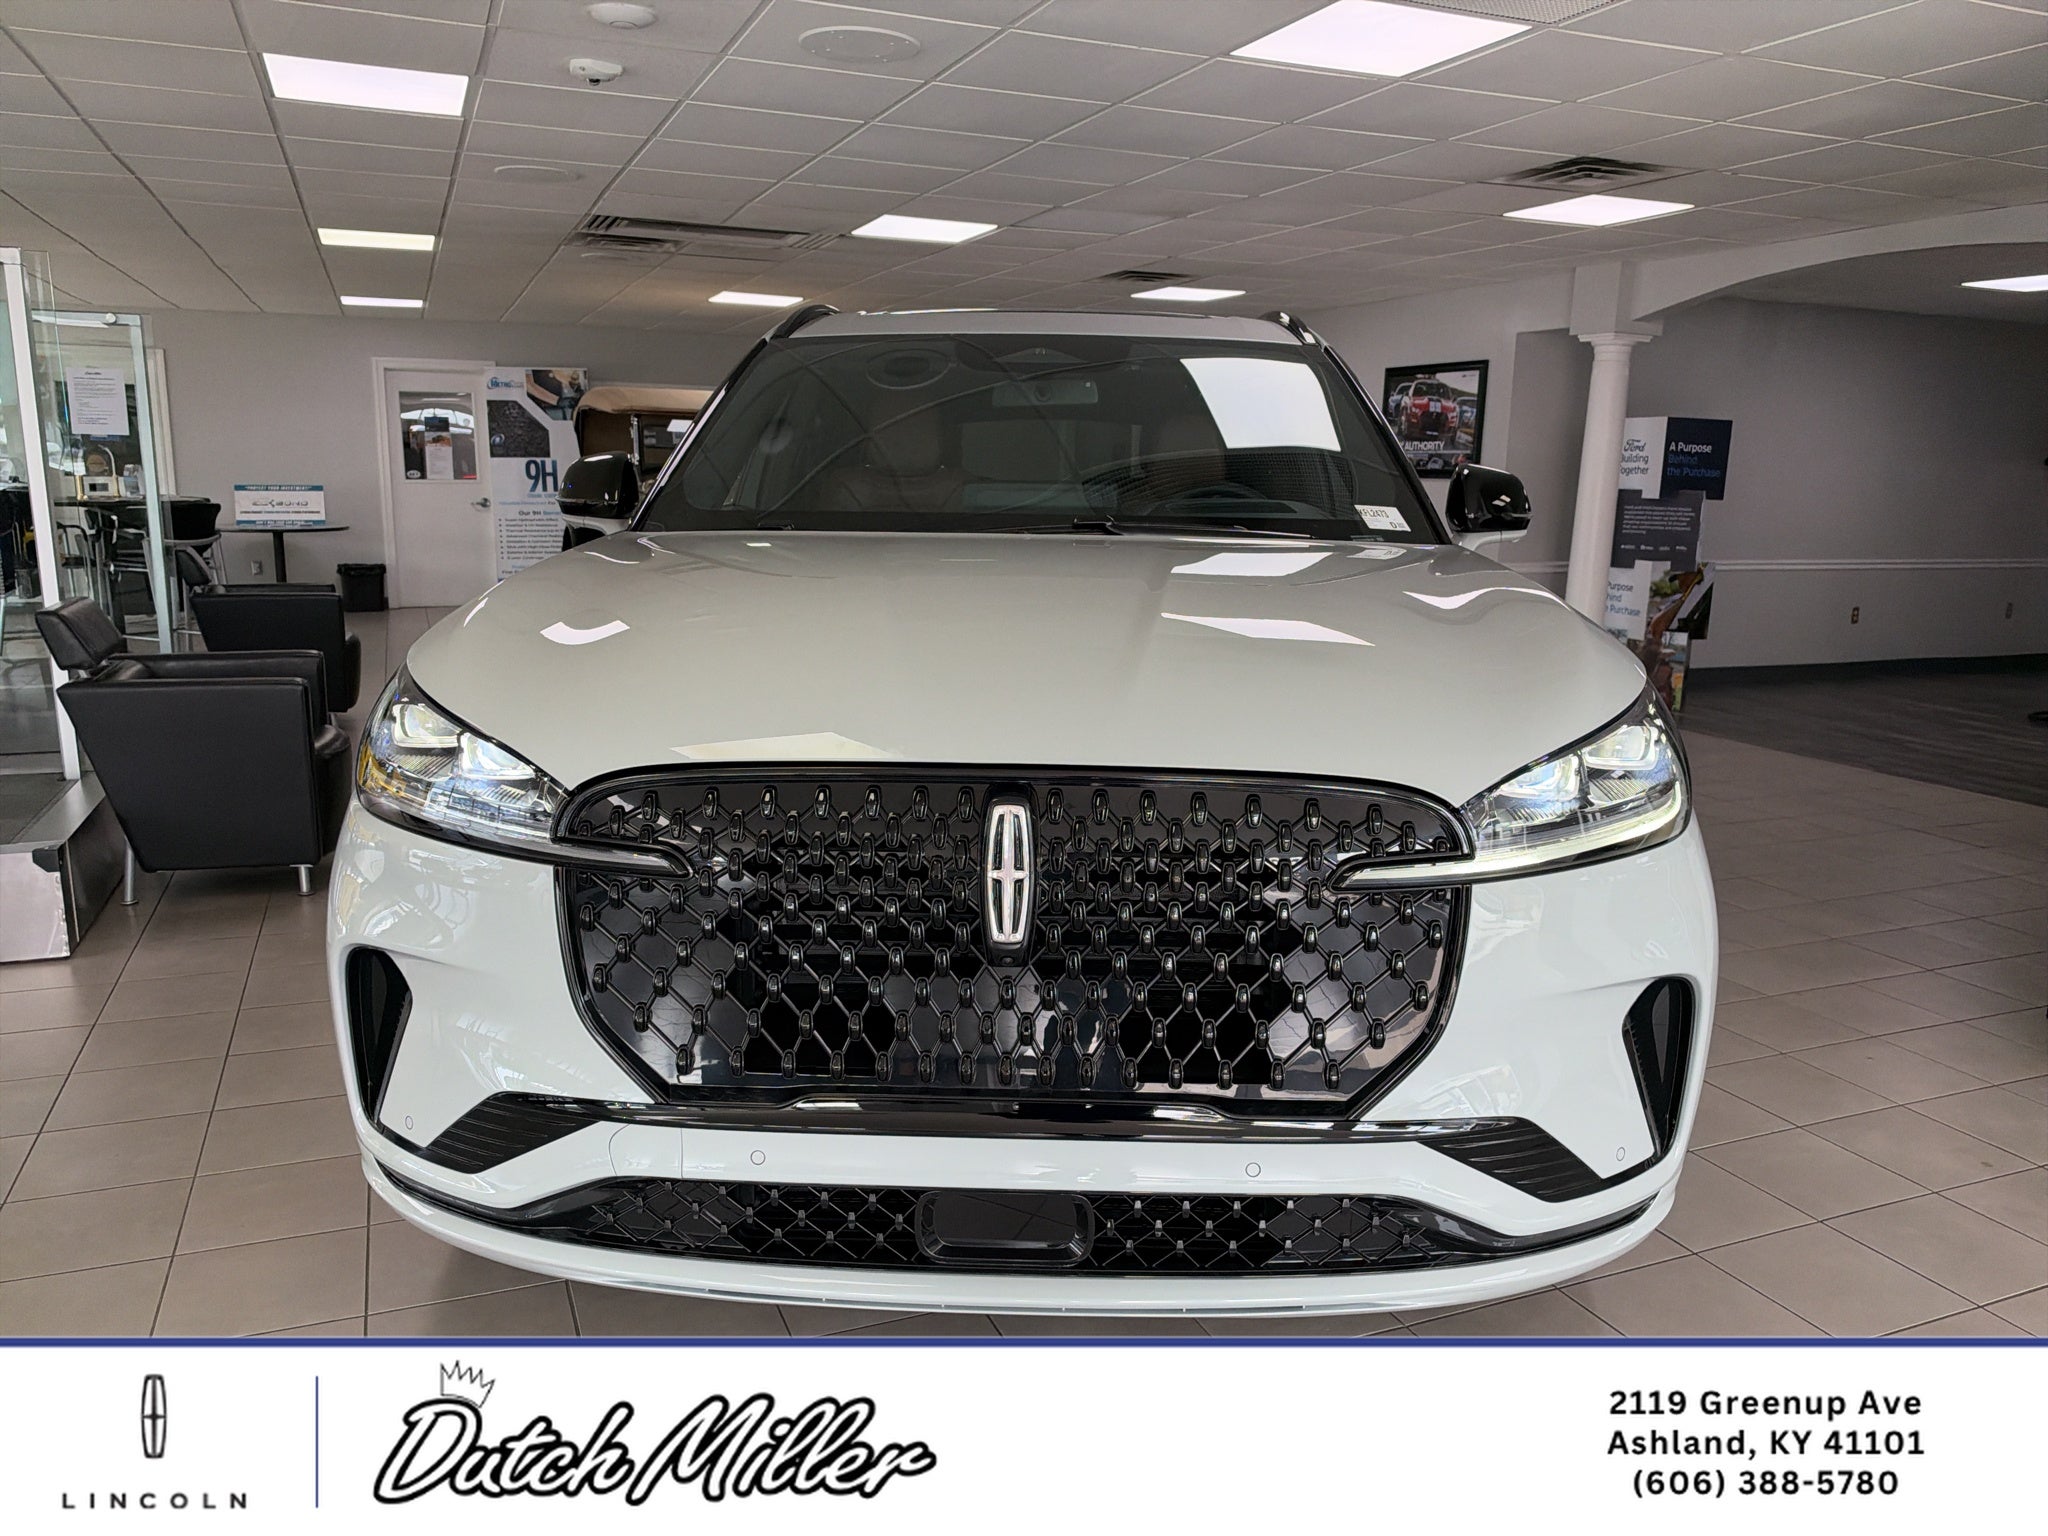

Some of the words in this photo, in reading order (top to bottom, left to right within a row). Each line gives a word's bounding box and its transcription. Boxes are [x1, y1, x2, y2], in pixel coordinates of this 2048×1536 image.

[1404, 440, 1446, 451] AUTHORITY
[1623, 439, 1647, 453] Ford
[1669, 441, 1676, 452] A
[1677, 441, 1713, 454] Purpose
[1668, 454, 1698, 464] Behind
[525, 459, 559, 493] 9H
[1667, 466, 1681, 476] the
[1682, 467, 1721, 477] Purchase
[1609, 604, 1641, 616] Purchase
